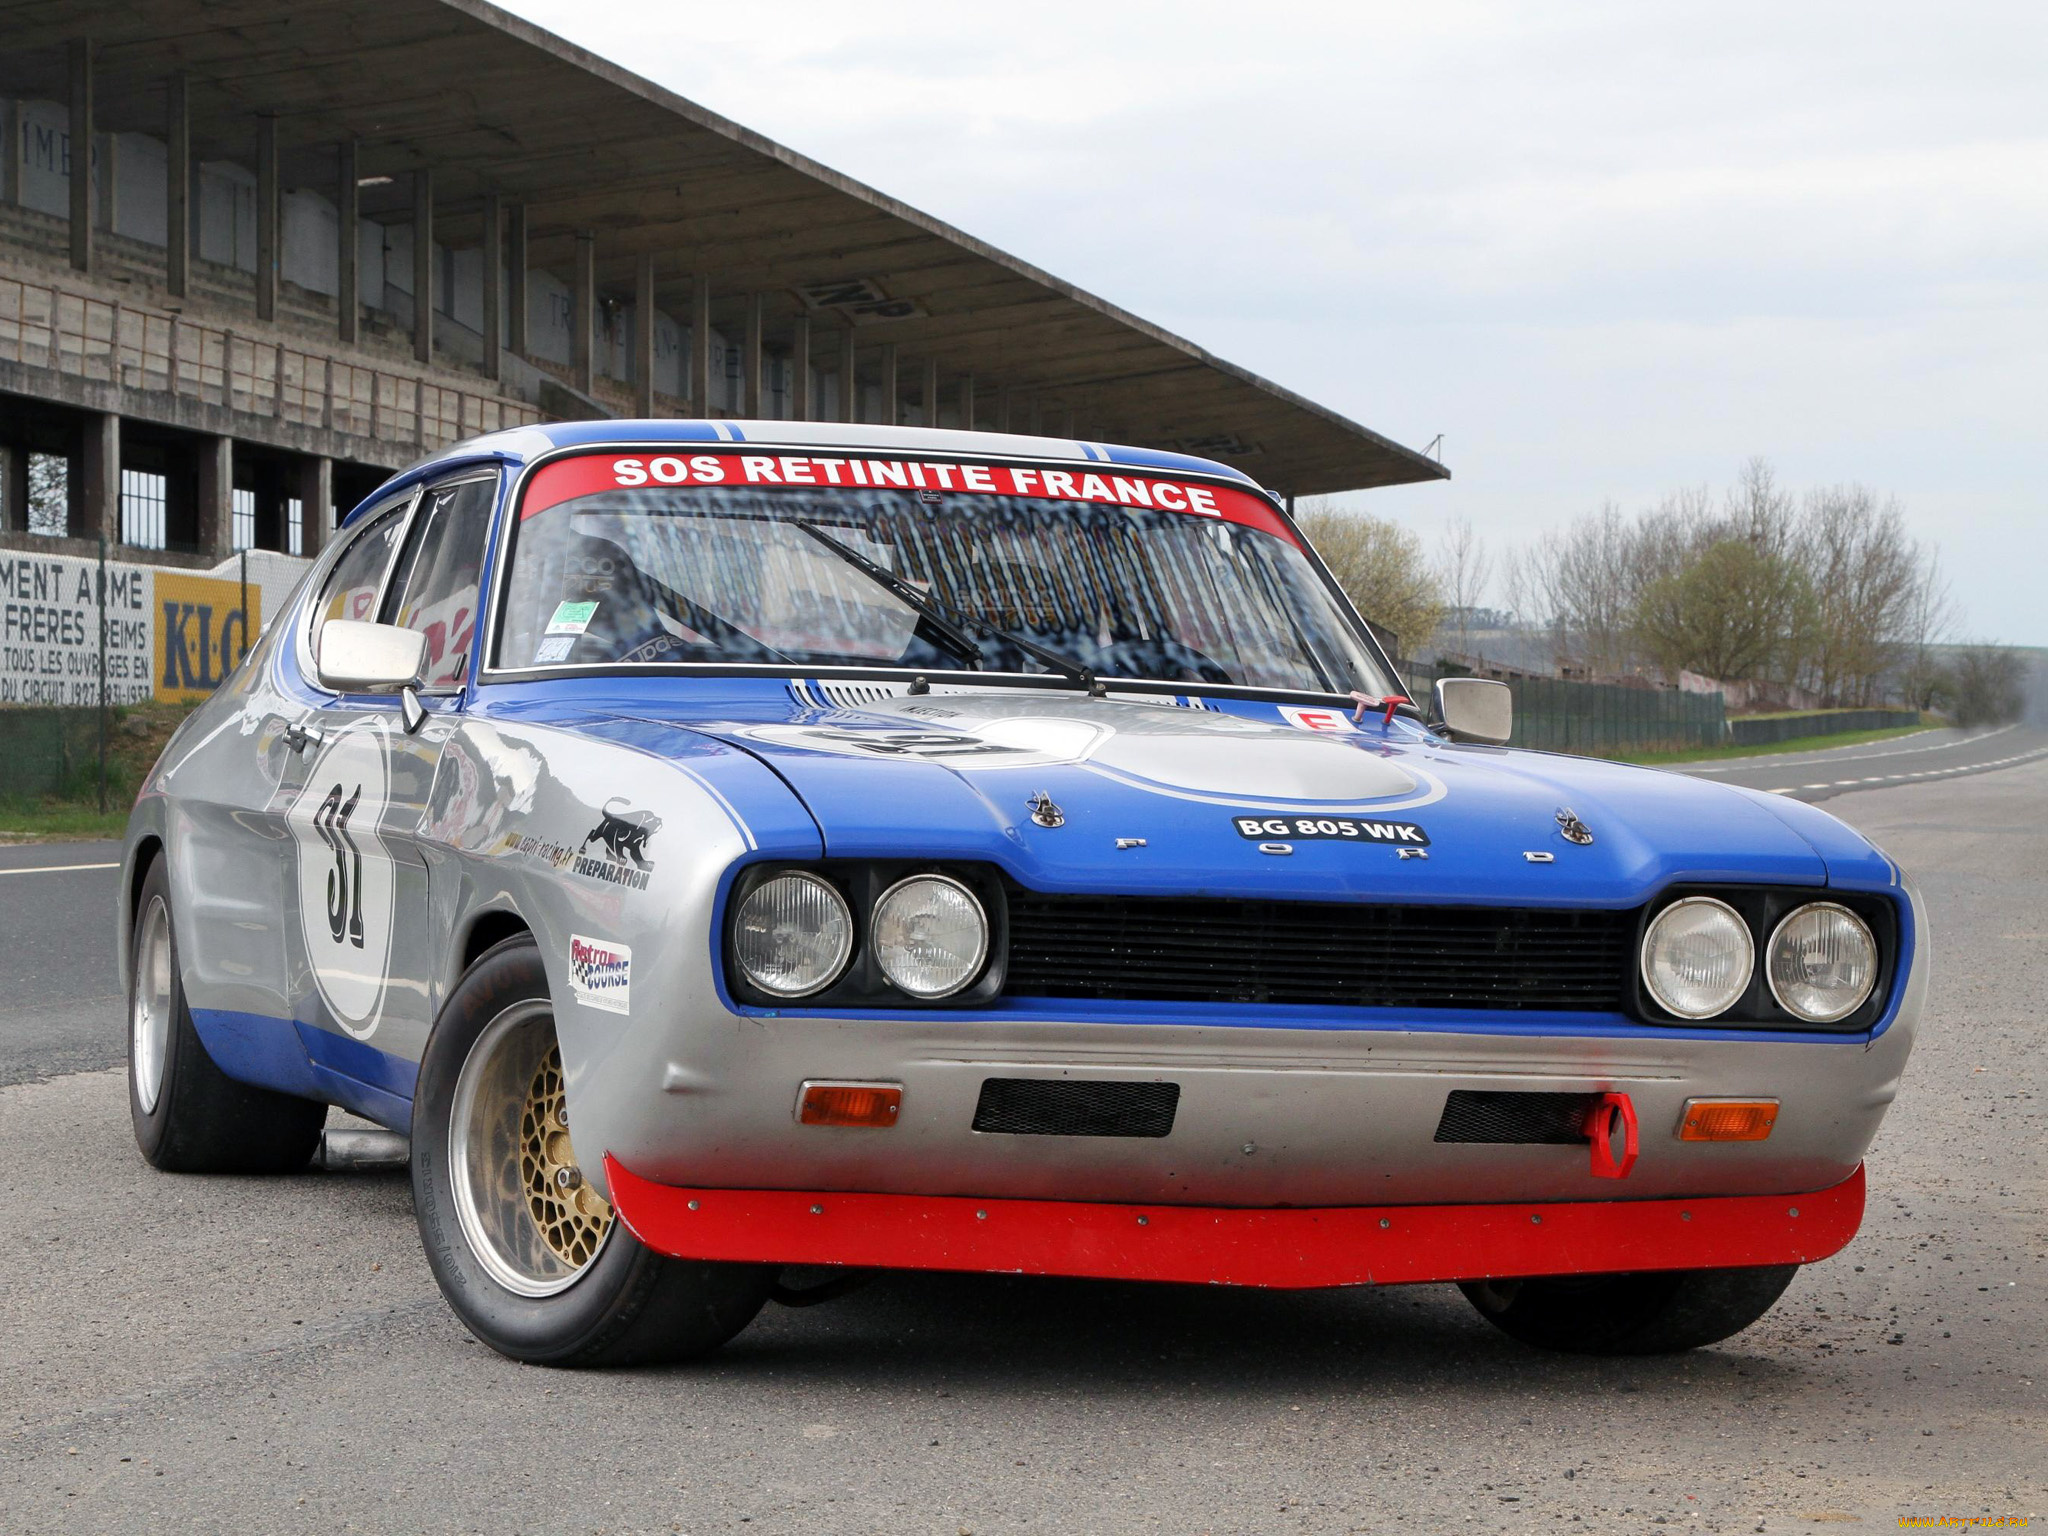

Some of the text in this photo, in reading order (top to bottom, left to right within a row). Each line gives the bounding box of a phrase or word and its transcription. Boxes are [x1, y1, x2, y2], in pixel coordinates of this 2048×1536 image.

[613, 456, 1222, 517] SOS RETINITE FRANCE
[0, 559, 63, 601] MENT
[4, 647, 35, 673] TOUS
[41, 650, 62, 674] LES
[134, 656, 149, 679] EN
[2, 678, 17, 701] DU
[22, 679, 65, 703] CIRCUIT
[1238, 820, 1424, 842] BG 805 WK
[313, 783, 364, 949] 31
[572, 856, 651, 891] PREPARATION
[587, 961, 629, 990] COURSE
